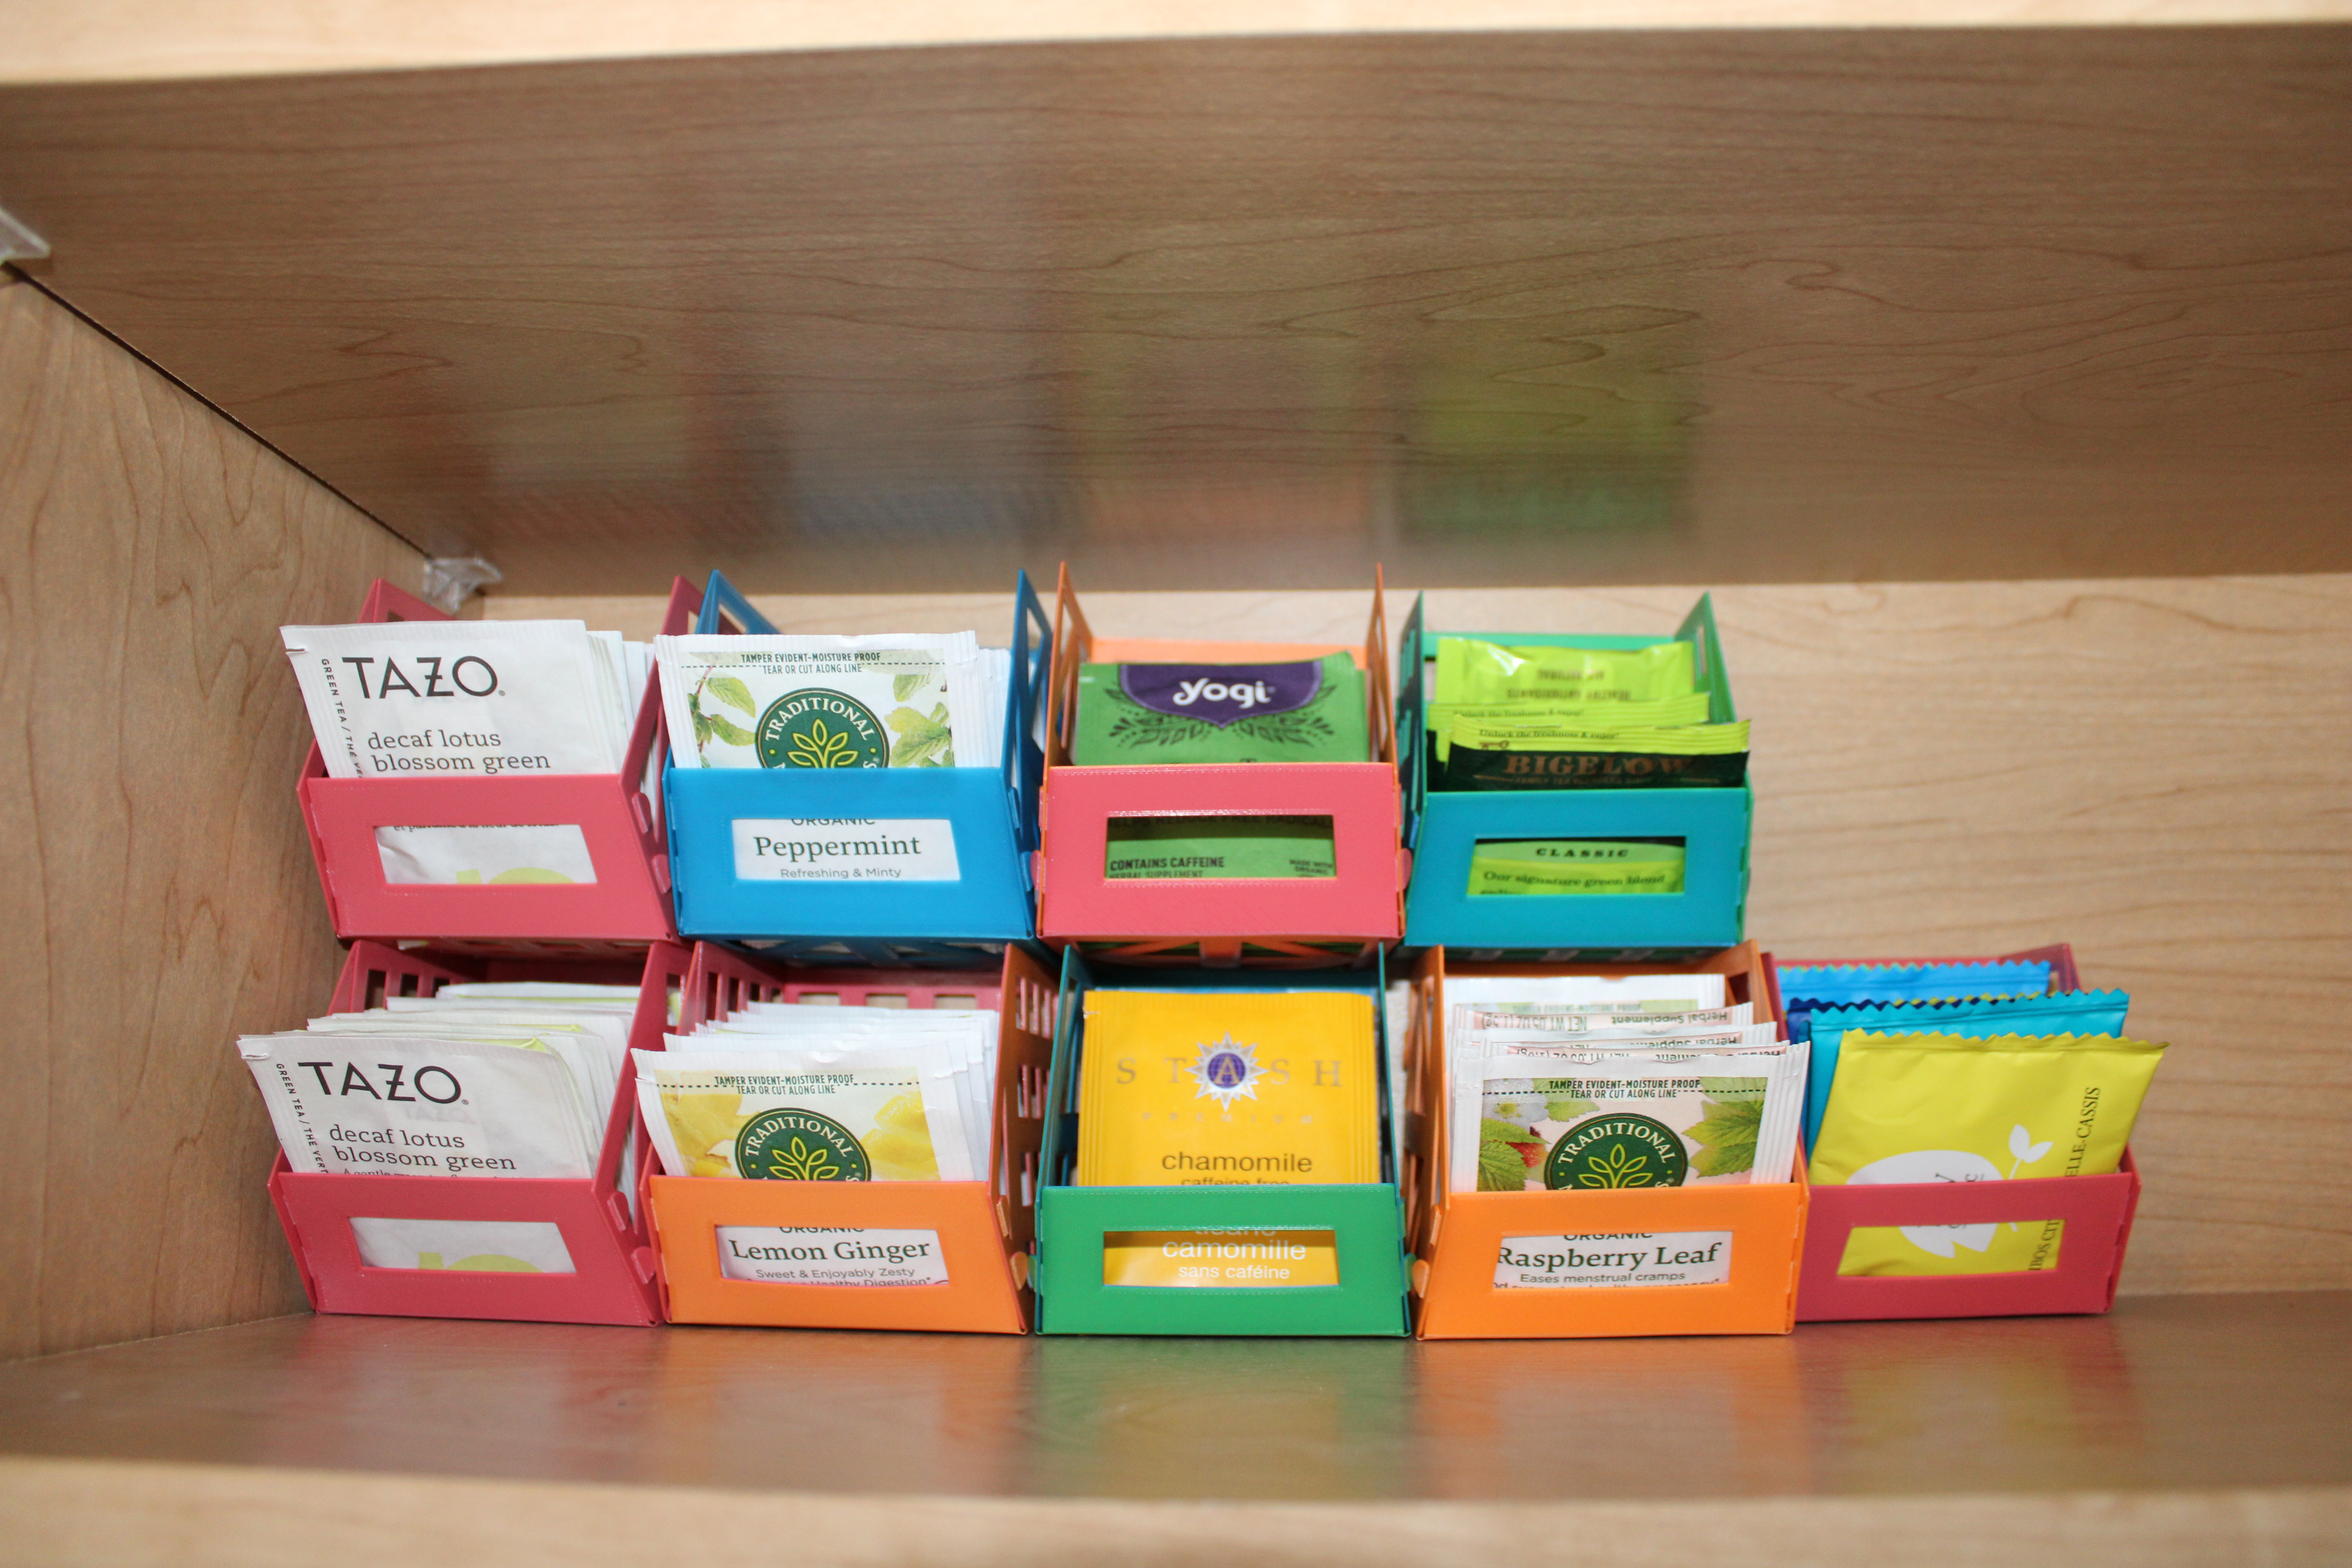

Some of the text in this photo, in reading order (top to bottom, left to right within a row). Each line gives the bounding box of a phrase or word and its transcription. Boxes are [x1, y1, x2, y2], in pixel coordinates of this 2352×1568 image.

[741, 652, 881, 663] TAMPER EVIDENT-MOISTURE PROOF
[341, 655, 498, 699] TAZO
[763, 663, 862, 674] TEAR OR CUT ALONG LINE
[1172, 677, 1271, 709] yogi
[321, 658, 339, 696] GREEN
[335, 701, 347, 722] TEA
[345, 736, 358, 758] THÉ
[353, 762, 364, 778] VE
[765, 697, 875, 741] TRADITIONAL
[368, 729, 501, 750] decaf lotus
[370, 753, 551, 774] blossom green
[1504, 754, 1690, 775] BIGELOW
[753, 835, 922, 862] Peppermint
[1535, 848, 1629, 857] CLASSIC
[780, 867, 902, 878] Refreshing & Minty
[1110, 857, 1225, 871] CONTAINS CAFFEINE
[1483, 871, 1512, 882] Our
[1515, 875, 1582, 886] signature
[1584, 877, 1624, 888] green
[1612, 1011, 1728, 1025] Herbal Supplement
[714, 1074, 854, 1085] TAMPER EVIDENT-MOISTURE PROOF
[1116, 1055, 1343, 1087] STASH
[297, 1061, 461, 1104] TAZO
[736, 1085, 835, 1095] TEAR OR CUT ALONG LINE
[1549, 1080, 1700, 1089] TAMPER EVIDENT-MOISTURE PROOF
[1571, 1089, 1677, 1098] TEAR OR CUT ALONG LINE
[276, 1063, 297, 1095] GREEN
[292, 1098, 305, 1118] TEA
[303, 1128, 318, 1147] THÉ
[313, 1150, 328, 1173] VERT
[1142, 1112, 1312, 1124] PREMIUM
[330, 1123, 465, 1148] decaf lotus
[745, 1116, 854, 1157] TRADITIONAL
[1557, 1122, 1676, 1164] TRADITIONAL
[332, 1145, 517, 1171] blossom green
[1161, 1151, 1312, 1172] chamomile
[728, 1240, 931, 1264] Lemon Ginger
[1162, 1240, 1306, 1260] camomille
[1497, 1242, 1722, 1273] Raspberry Leaf
[756, 1269, 795, 1278] Sweet
[812, 1269, 875, 1279] Enjoyably
[879, 1268, 915, 1278] Zesty
[1178, 1265, 1290, 1279] sans caféine
[1520, 1272, 1685, 1283] Eases menstrual cramps
